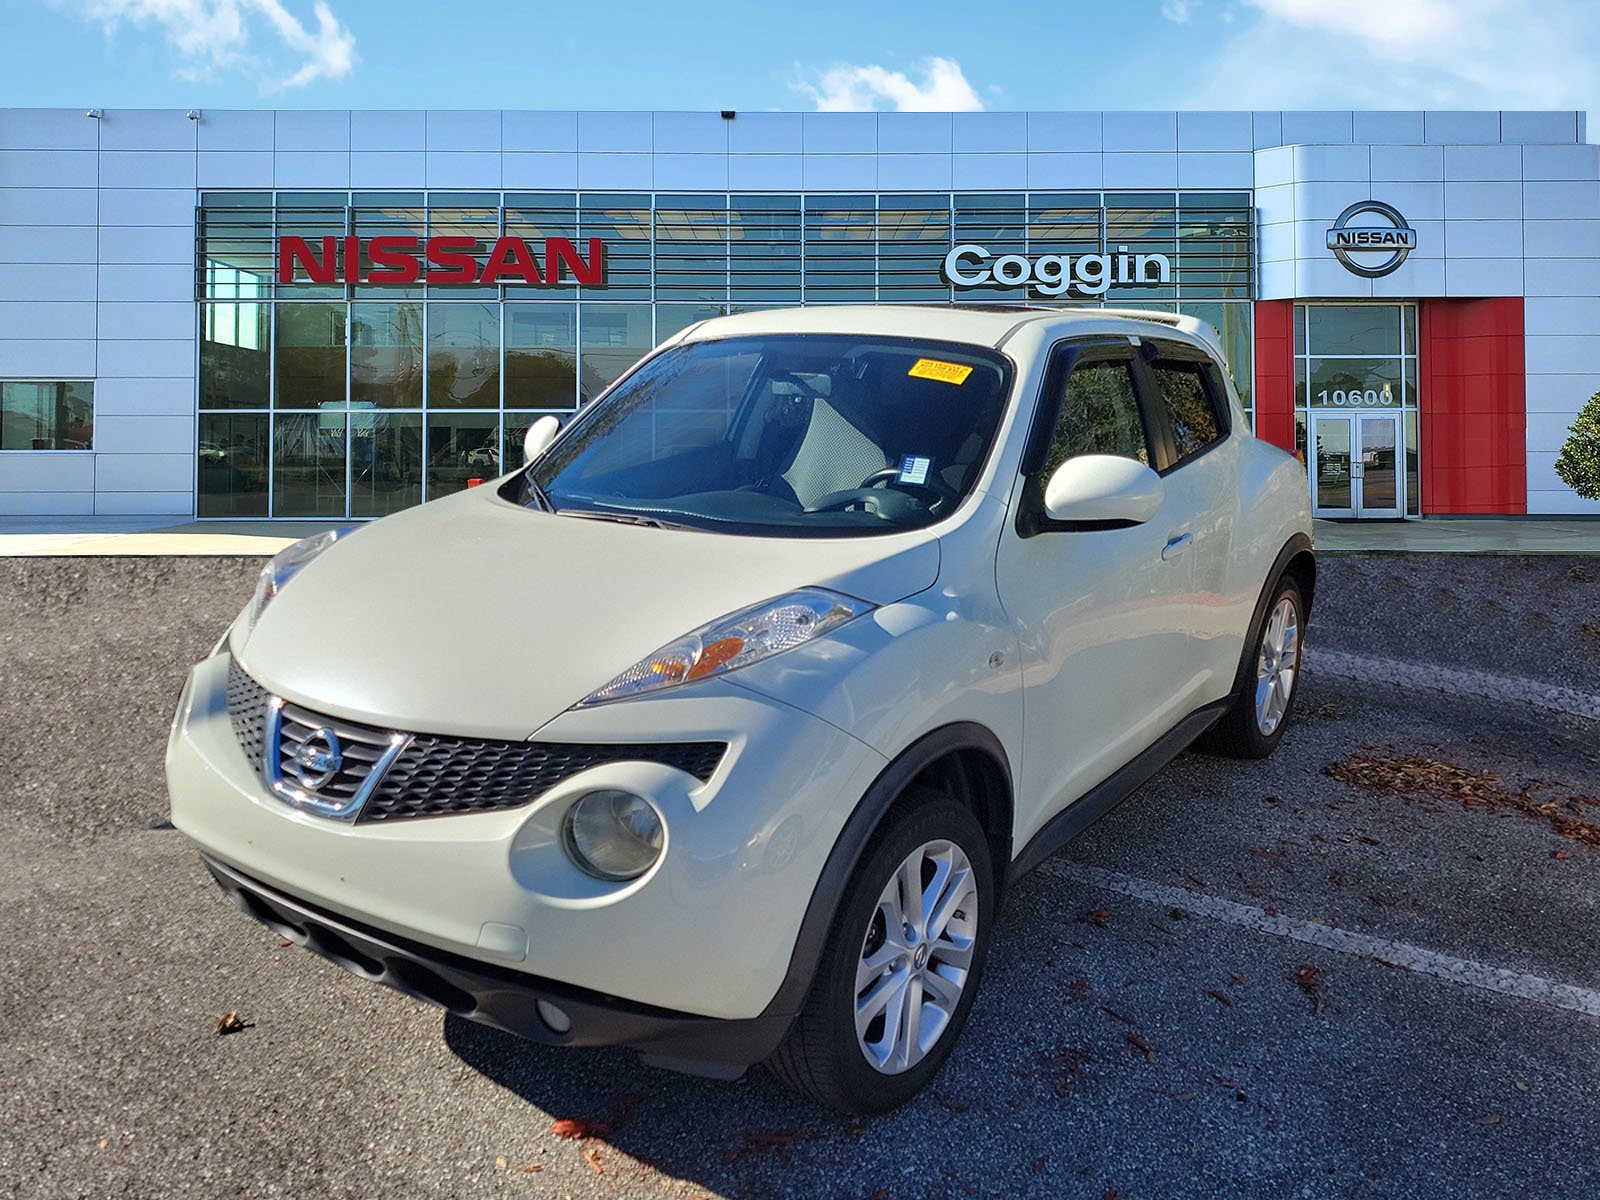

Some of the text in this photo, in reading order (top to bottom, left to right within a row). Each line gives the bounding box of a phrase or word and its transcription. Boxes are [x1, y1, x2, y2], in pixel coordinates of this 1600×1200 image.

[1336, 232, 1408, 245] NISSAN
[279, 235, 602, 284] NISSAN
[944, 244, 1170, 295] Coggin
[1318, 389, 1393, 405] 10600
